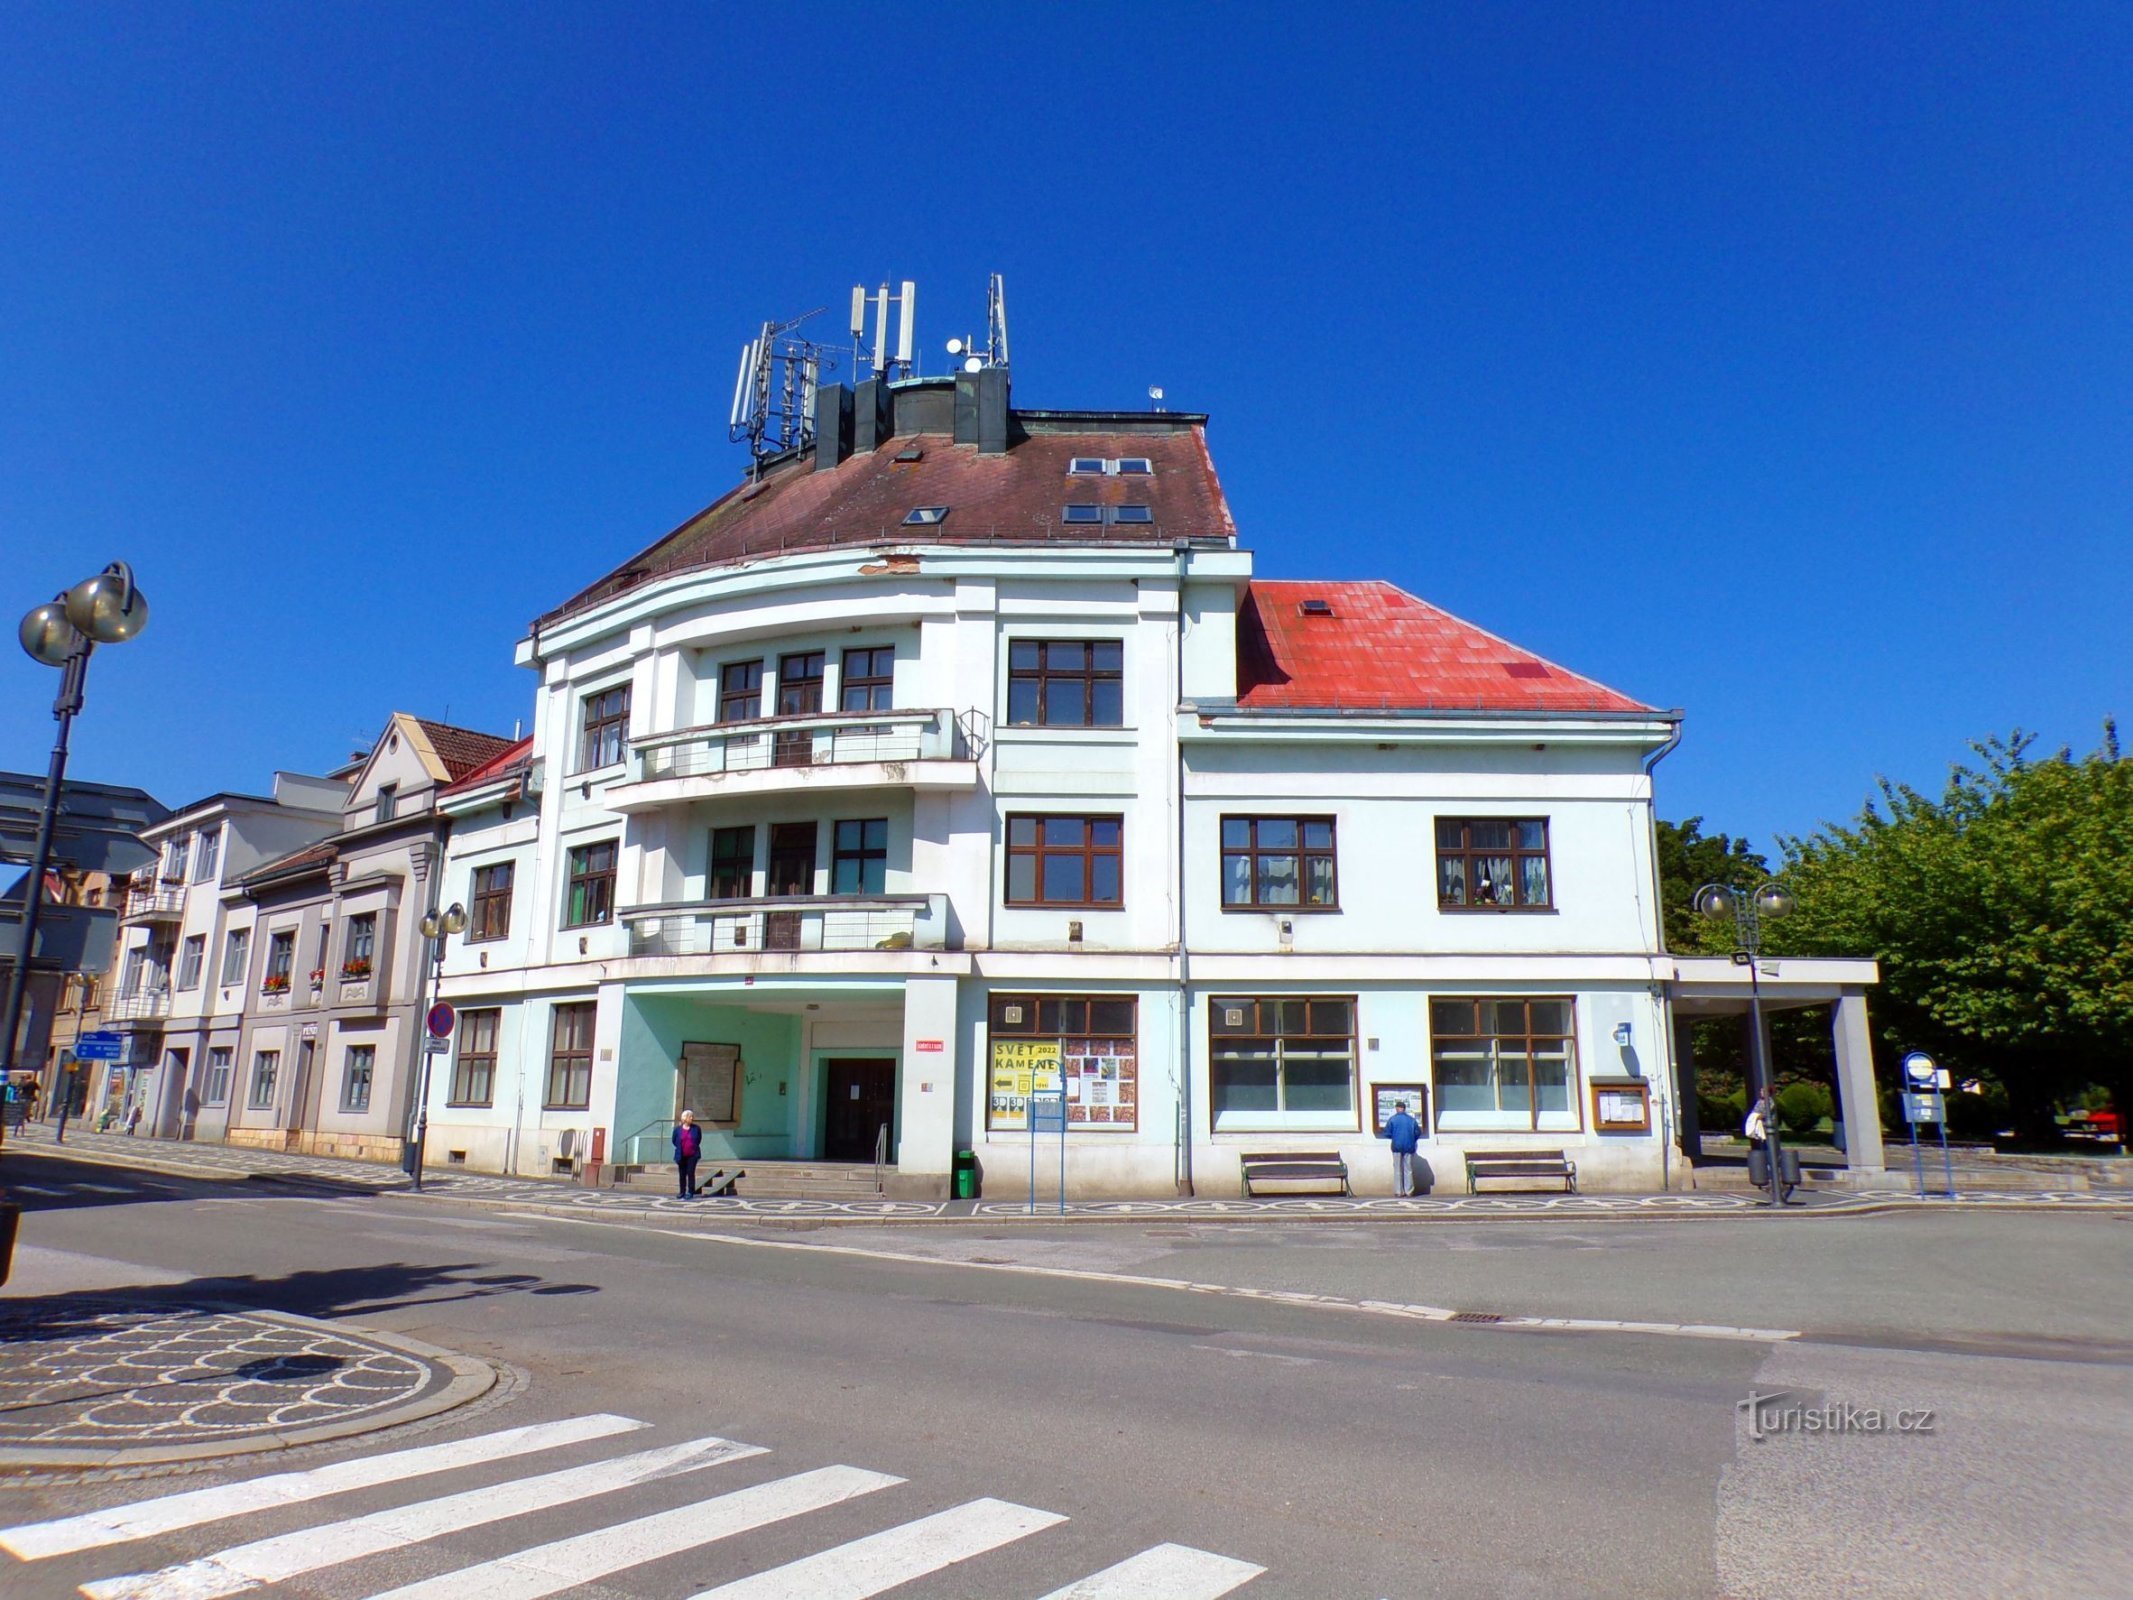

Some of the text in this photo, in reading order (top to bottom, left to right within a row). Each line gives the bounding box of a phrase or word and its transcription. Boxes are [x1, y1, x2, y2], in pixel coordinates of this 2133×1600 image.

[996, 1043, 1056, 1056] SVĚT 2022
[995, 1058, 1055, 1070] KAMENE
